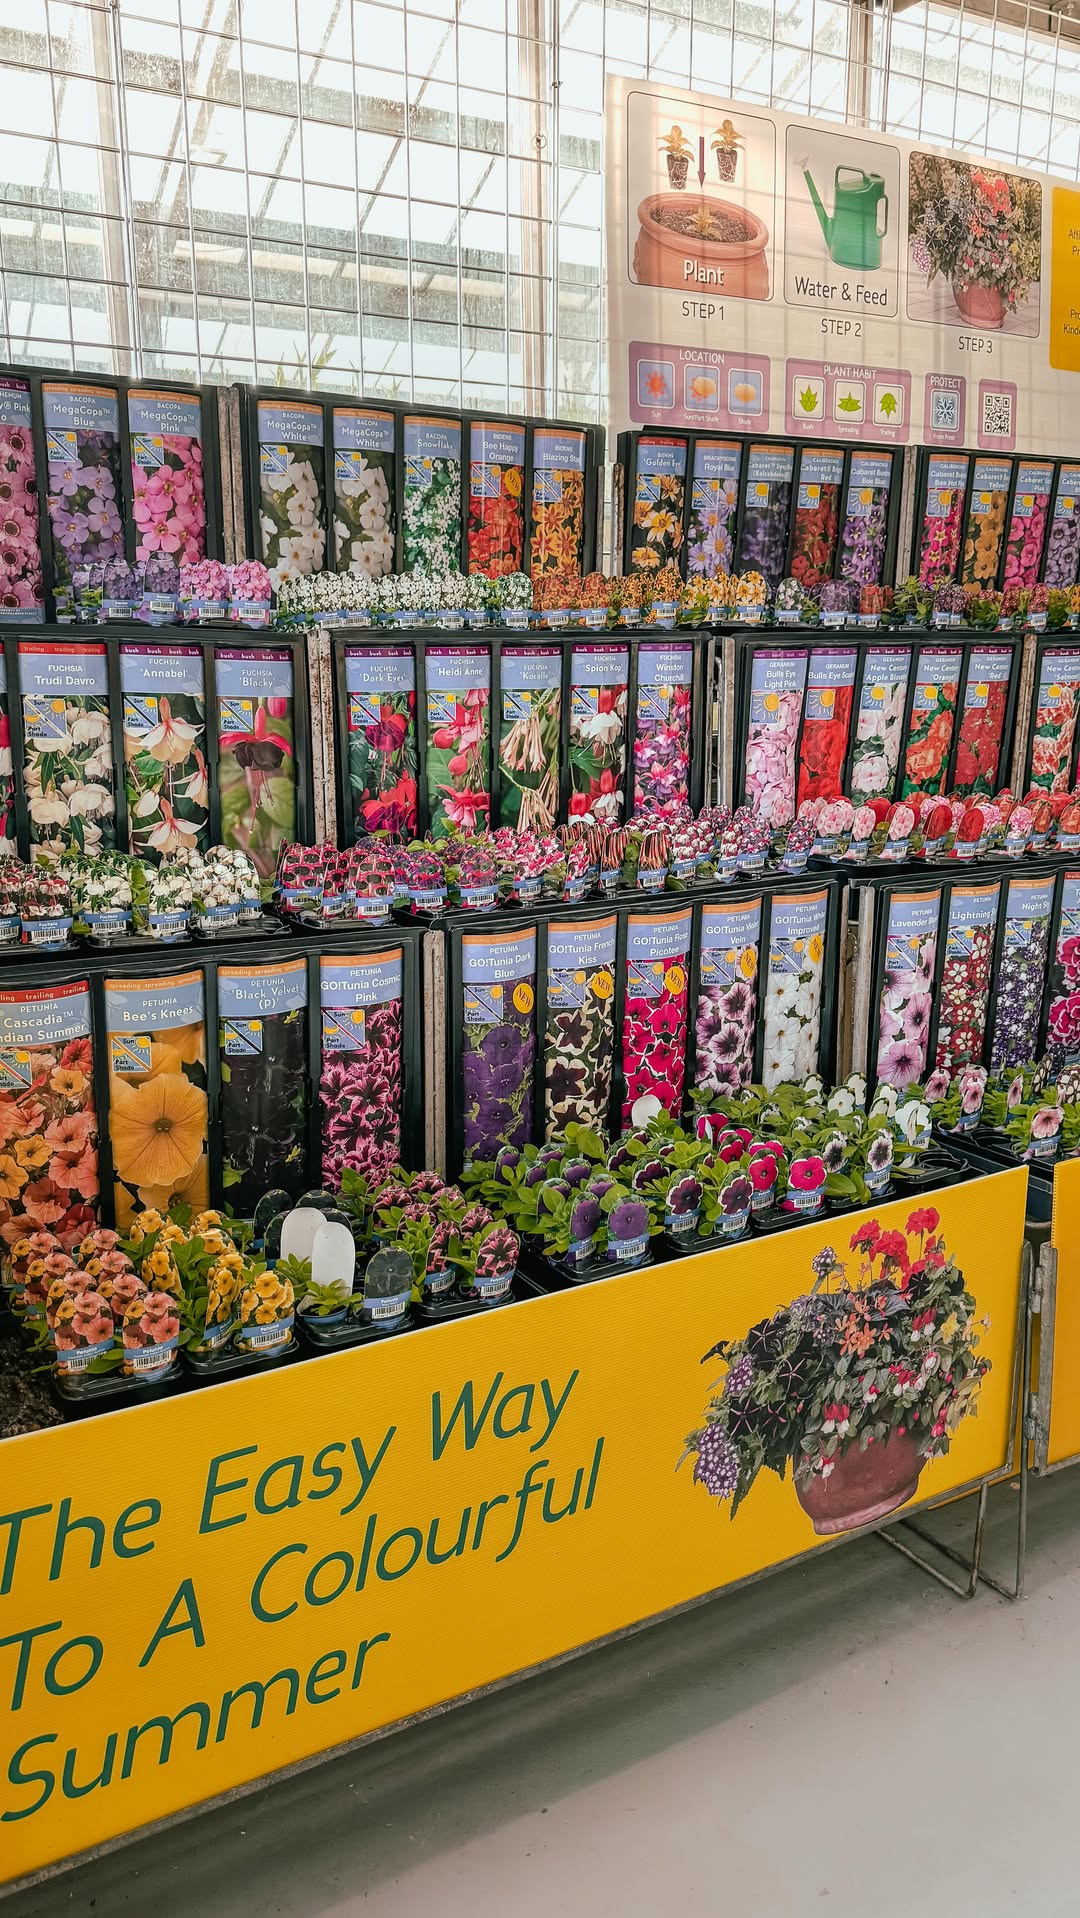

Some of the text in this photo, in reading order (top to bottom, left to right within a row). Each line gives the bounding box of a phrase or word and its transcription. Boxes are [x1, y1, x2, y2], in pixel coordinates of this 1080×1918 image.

[683, 259, 724, 285] Plant
[795, 276, 887, 307] Water & Feed
[682, 301, 724, 320] STEP 1
[821, 319, 861, 337] STEP 2
[958, 336, 993, 353] STEP 3
[680, 349, 724, 364] LOCATION
[824, 365, 877, 379] PLANT HABIT
[931, 376, 961, 388] PROTECT
[70, 396, 95, 404] BACOPA
[14, 402, 30, 413] Pink
[282, 412, 305, 420] BACOPA
[74, 417, 94, 427] Blue
[161, 422, 180, 432] Pink
[281, 432, 307, 441] White
[355, 438, 379, 448] White
[483, 441, 519, 453] Bee Happy
[489, 452, 513, 462] Orange
[543, 453, 568, 463] Blazing
[704, 463, 735, 472] Royal Blue
[507, 473, 520, 492] NEW
[140, 668, 189, 678] 'Annabel'
[436, 667, 462, 676] 'Heidi
[583, 664, 608, 672] 'Spion
[35, 675, 95, 686] Trudi Davro
[359, 673, 384, 682] 'Dark
[655, 673, 684, 682] Churchill
[829, 672, 841, 680] Eye
[240, 677, 276, 688] 'Blacky'
[765, 680, 783, 689] Light
[795, 905, 818, 913] PETUNIA
[1022, 902, 1042, 911] Night
[727, 914, 750, 923] PETUNIA
[775, 916, 812, 924] GO!Tunia
[891, 919, 927, 927] Lavender
[654, 925, 679, 933] PETUNIA
[706, 920, 759, 934] GO!Tunia Violet
[787, 925, 820, 935] Improved
[574, 933, 601, 941] PETUNIA
[633, 932, 688, 945] GO!Tunia Rose
[730, 936, 746, 944] Vein
[490, 945, 518, 954] PETUNIA
[549, 938, 615, 953] GO!Tunia French
[650, 946, 679, 956] Picotee
[469, 952, 531, 967] GO!Tunia Dark
[579, 956, 597, 964] Kiss
[745, 954, 754, 972] NEW
[255, 967, 282, 975] spreading
[350, 967, 382, 977] PETUNIA
[495, 970, 515, 978] Blue
[145, 980, 175, 989] spreading
[251, 978, 285, 987] PETUNIA
[321, 974, 401, 991] GO!Tunia Cosmic
[595, 977, 611, 992] NEW
[668, 971, 682, 988] NEW
[26, 985, 86, 1000] trailing trailing
[232, 984, 300, 999] 'Black Velvet
[356, 992, 377, 1002] Pink
[517, 987, 532, 1007] NEW
[142, 998, 178, 1007] PETUNIA
[20, 1003, 58, 1013] PETUNIA
[123, 1005, 193, 1022] Bee's Knees
[38, 1024, 86, 1040] Summer
[76, 1346, 98, 1356] Petunia
[142, 1346, 164, 1355] Petunia
[0, 1369, 580, 1596] The Easy Way
[0, 1436, 605, 1712] To A Colourful
[0, 1632, 390, 1822] Summer
